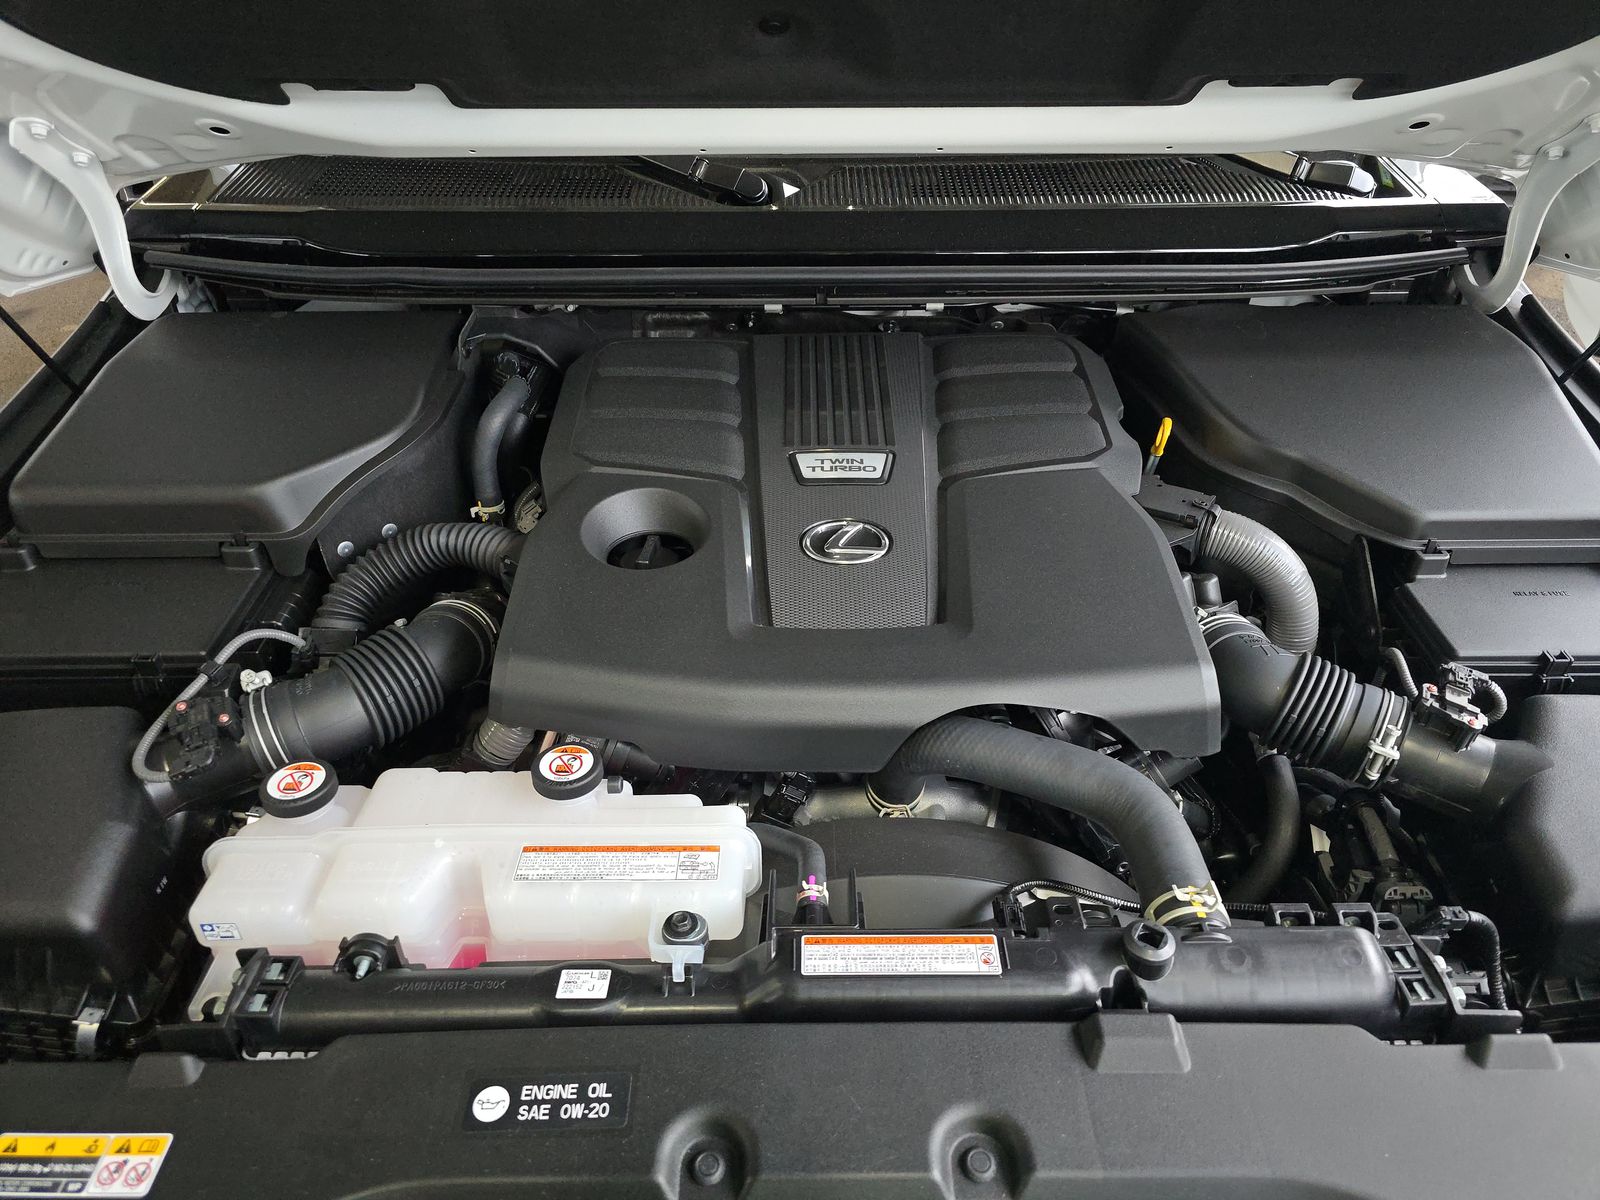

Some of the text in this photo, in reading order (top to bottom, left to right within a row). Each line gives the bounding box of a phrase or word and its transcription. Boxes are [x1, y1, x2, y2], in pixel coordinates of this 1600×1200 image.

[520, 1082, 613, 1100] ENGINE OIL
[516, 1102, 610, 1121] SAE 0W-20
